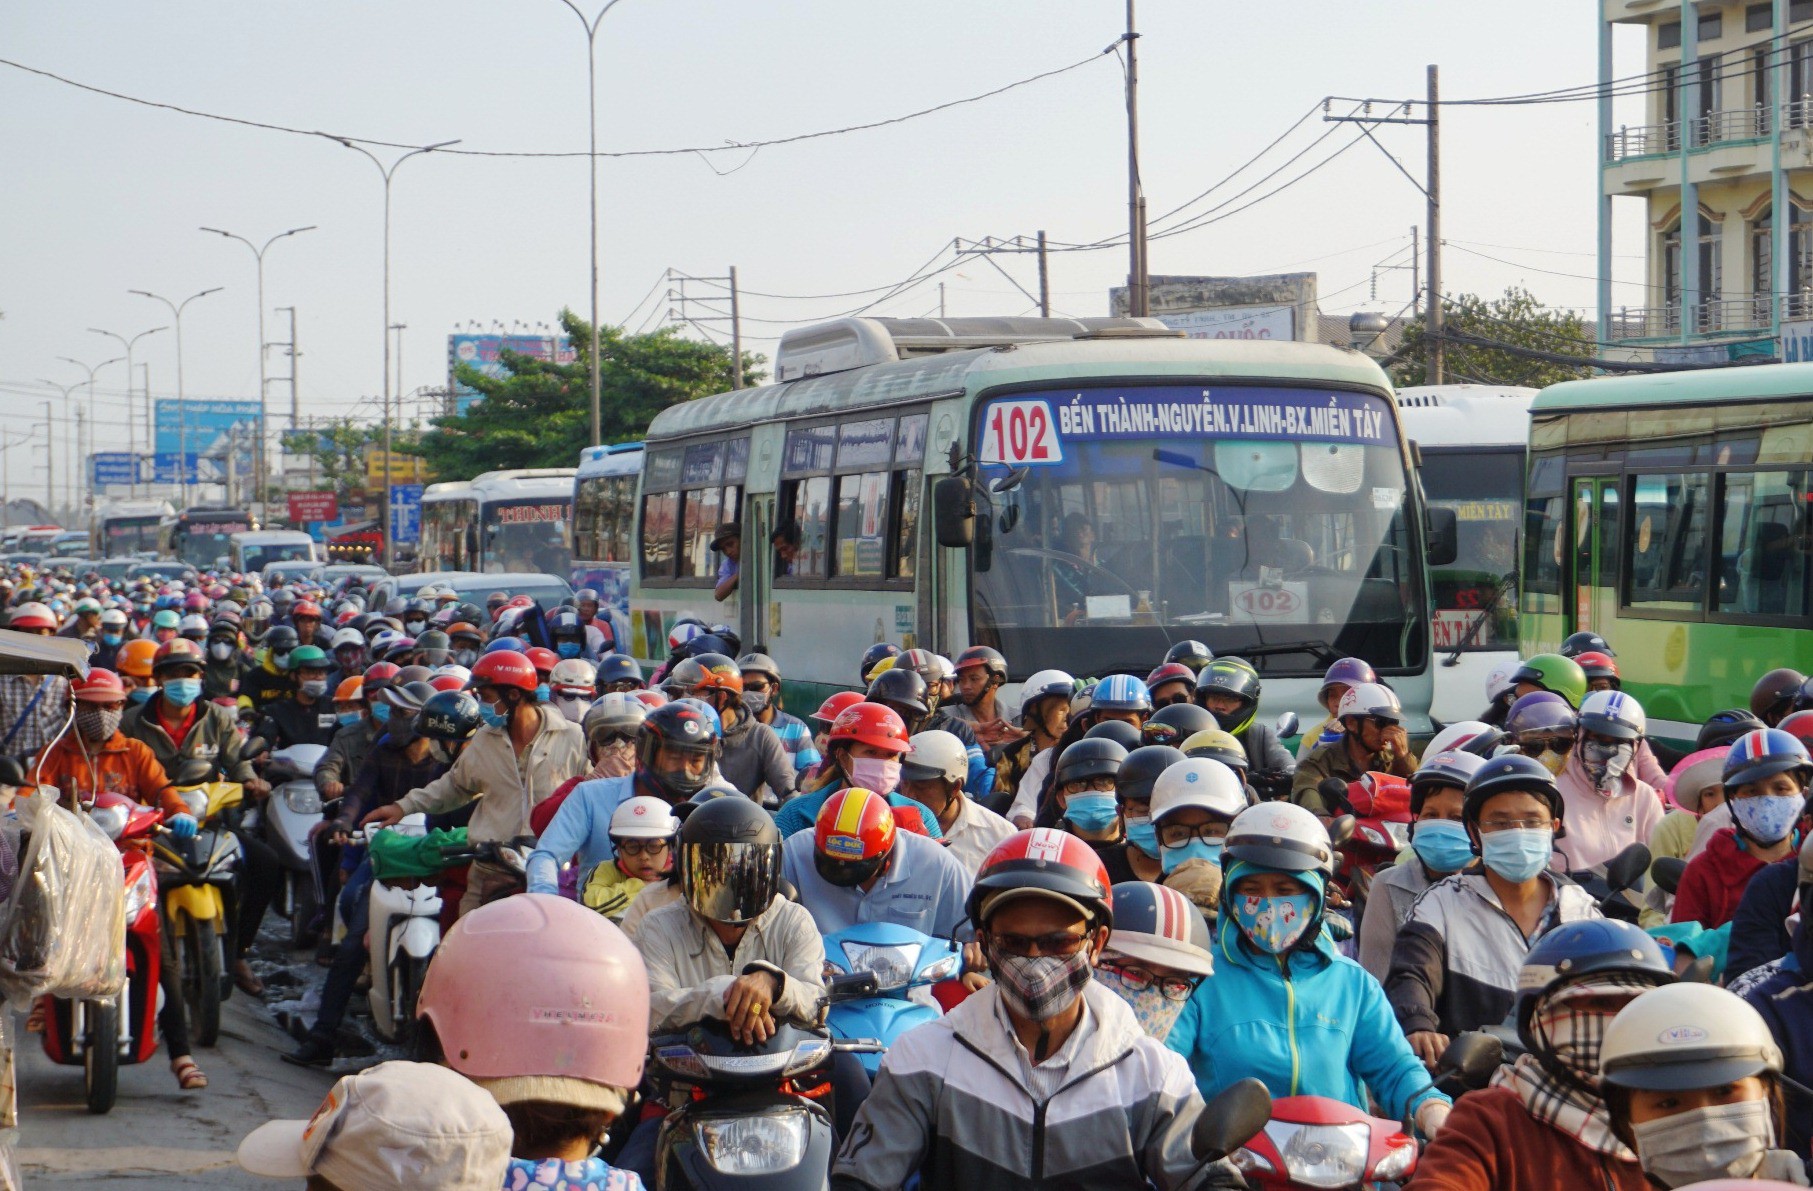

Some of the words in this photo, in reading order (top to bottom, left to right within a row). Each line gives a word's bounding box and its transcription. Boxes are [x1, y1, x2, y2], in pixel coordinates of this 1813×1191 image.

[992, 405, 1049, 460] 102
[1059, 394, 1094, 433] BẾN
[1353, 403, 1382, 439] TÂY
[1243, 591, 1292, 611] 102
